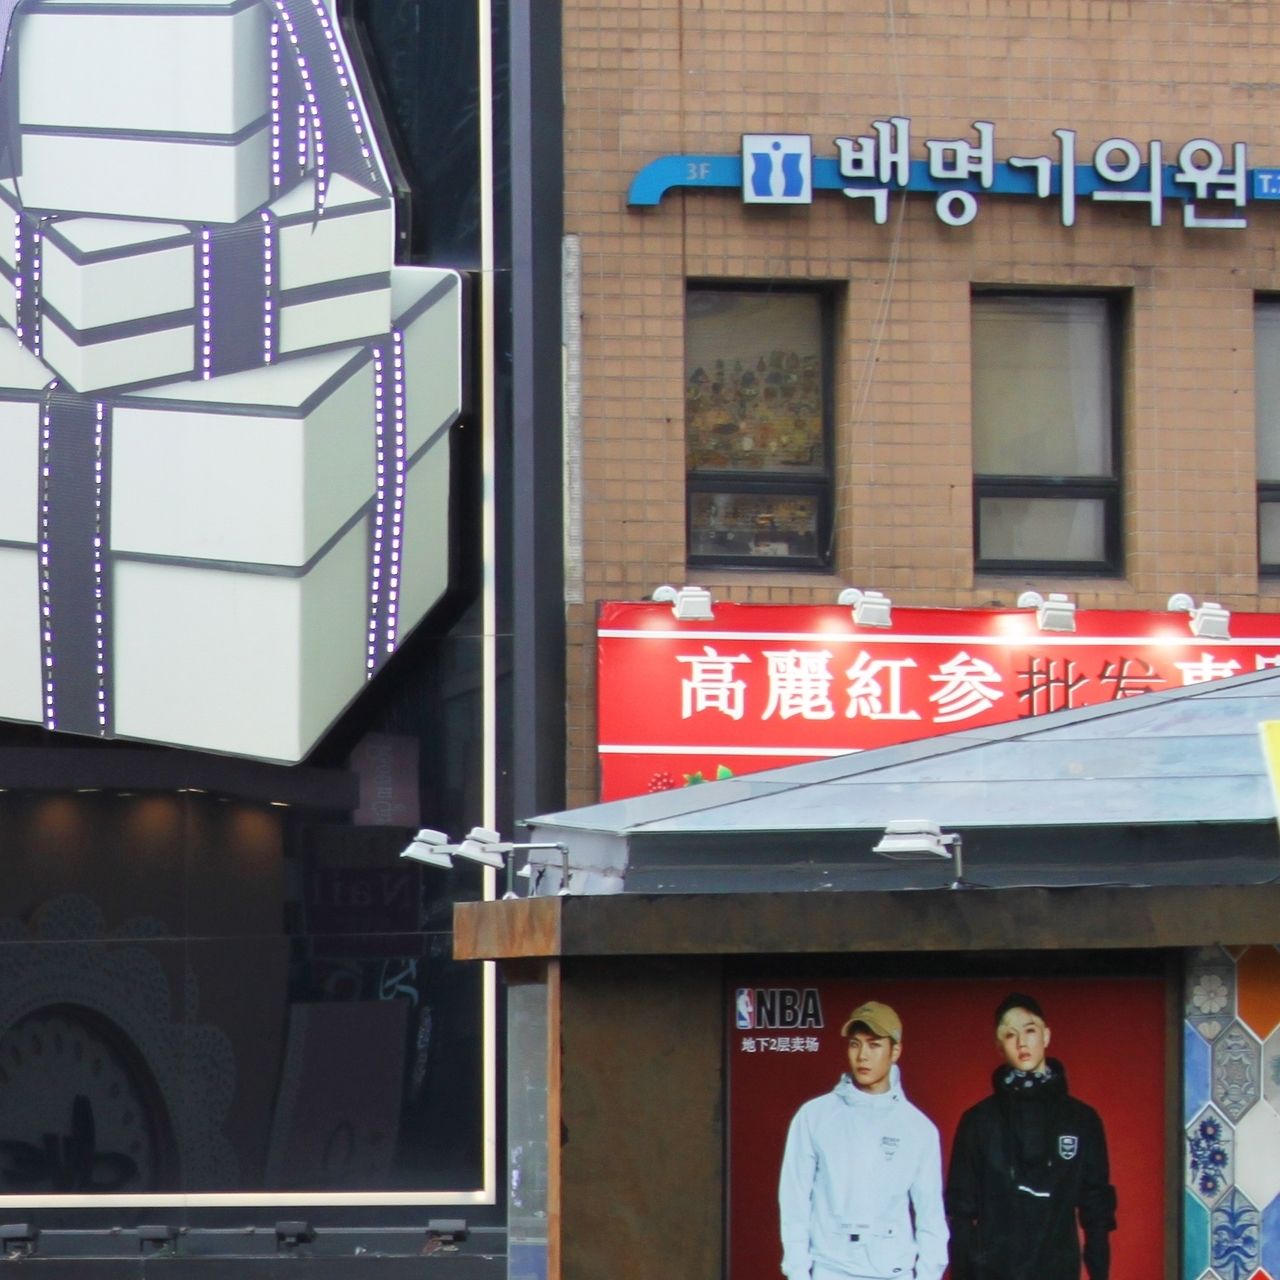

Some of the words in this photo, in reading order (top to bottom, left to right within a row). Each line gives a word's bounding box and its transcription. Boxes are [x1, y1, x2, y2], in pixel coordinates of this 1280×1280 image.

[685, 162, 712, 181] 3F
[835, 116, 1249, 230] 백명기의원
[753, 987, 825, 1030] NBA
[741, 1037, 820, 1054] 地下2层卖场
